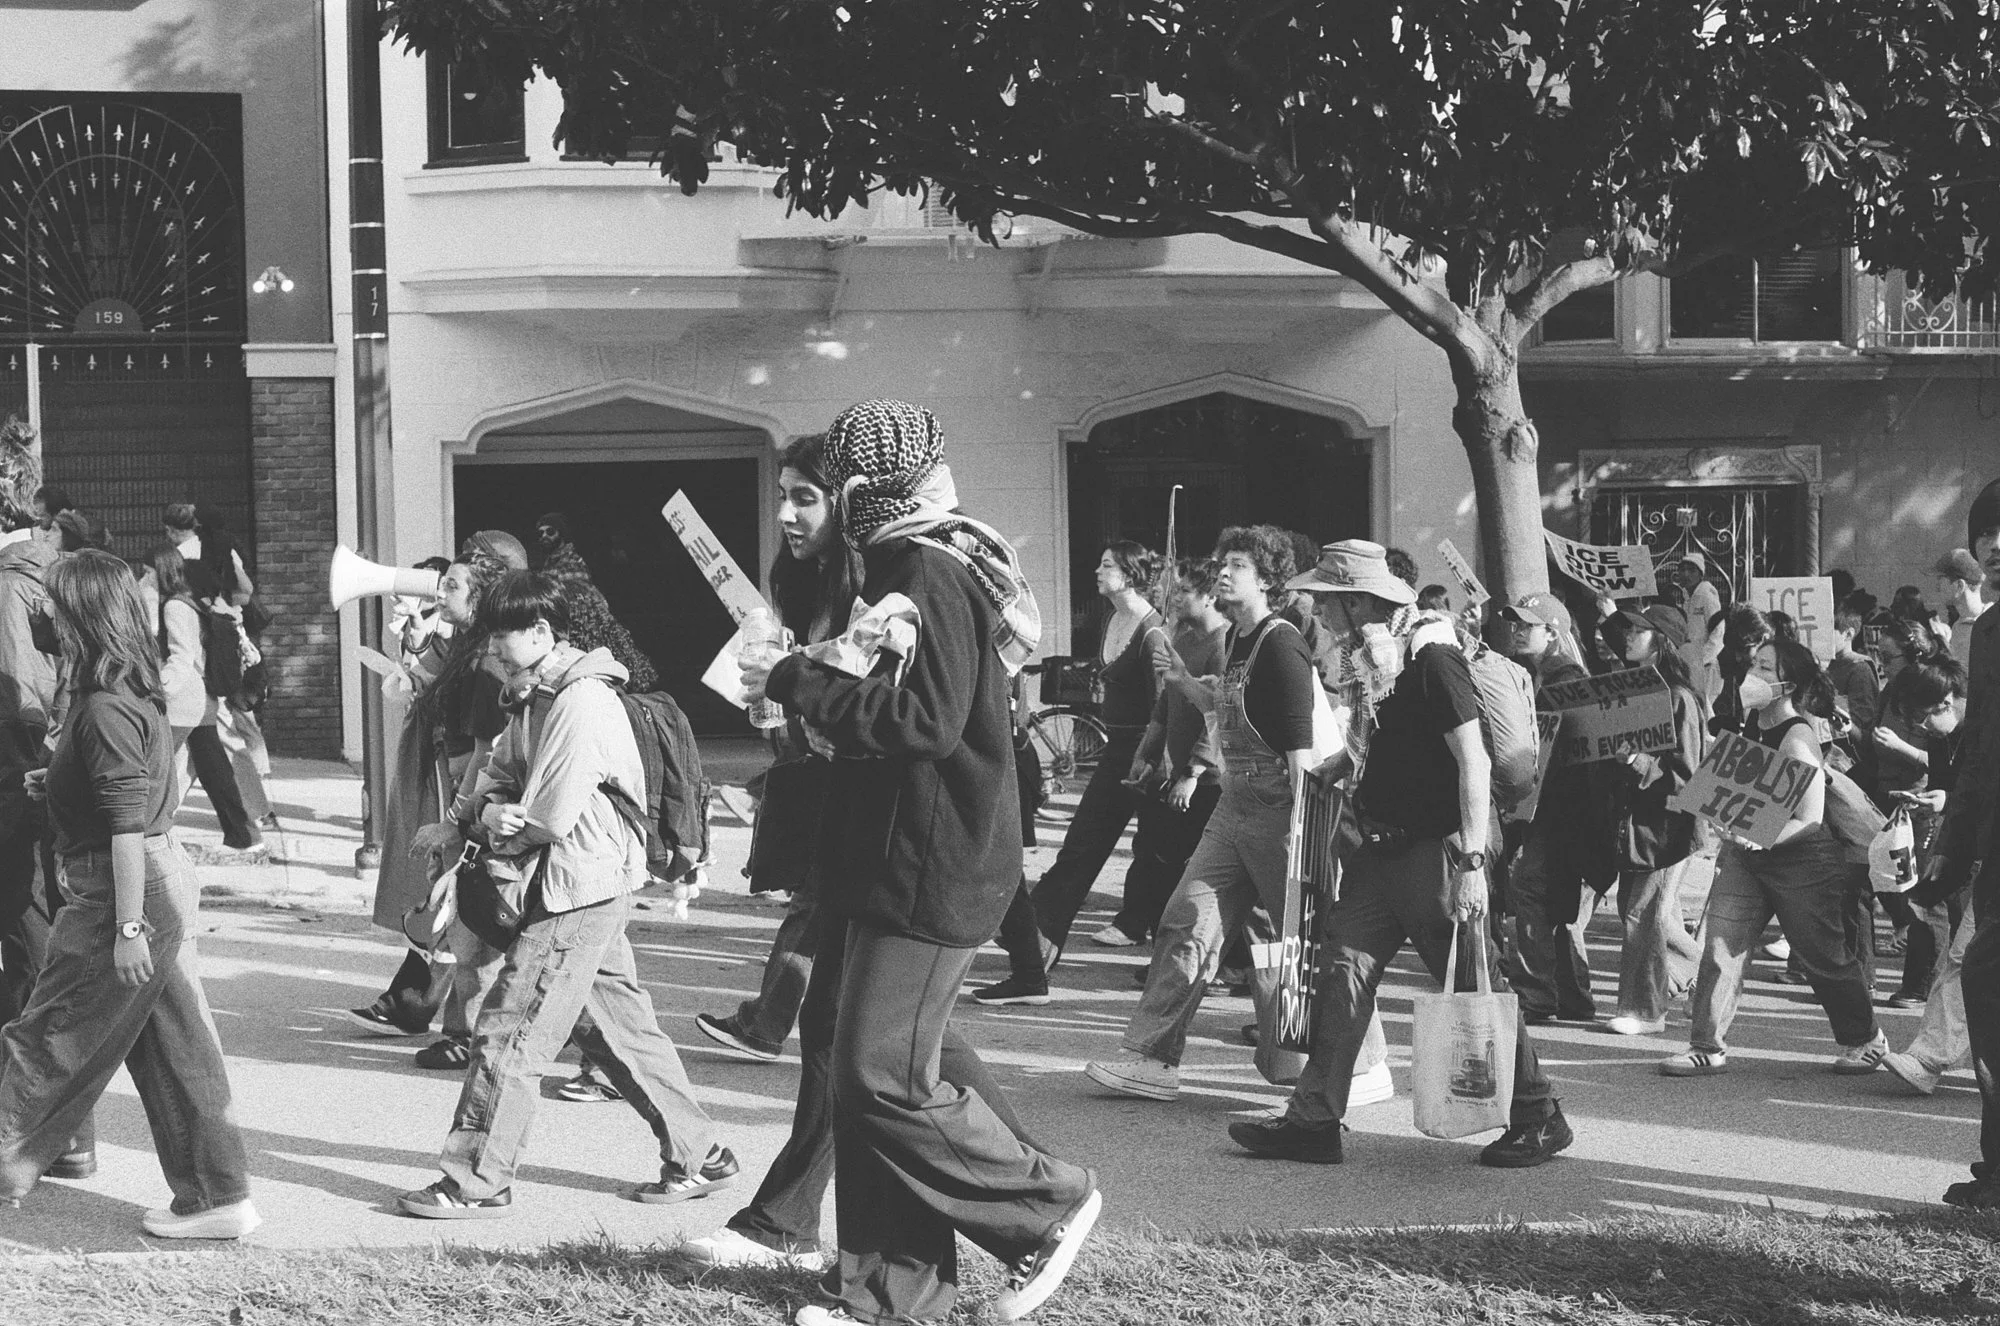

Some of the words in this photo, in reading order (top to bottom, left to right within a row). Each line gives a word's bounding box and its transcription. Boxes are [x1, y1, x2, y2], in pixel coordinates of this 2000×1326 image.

[95, 311, 123, 324] 159
[1565, 543, 1621, 565] ICE
[1565, 554, 1629, 578] OUT
[1566, 562, 1636, 591] NOW
[1766, 587, 1816, 621] ICE
[1548, 681, 1590, 707] DUE
[1589, 668, 1661, 698] PROCESS
[1598, 696, 1612, 710] IS
[1597, 721, 1674, 757] EVERYONE
[1700, 733, 1818, 813] ABOLISH
[1699, 785, 1766, 831] ICE
